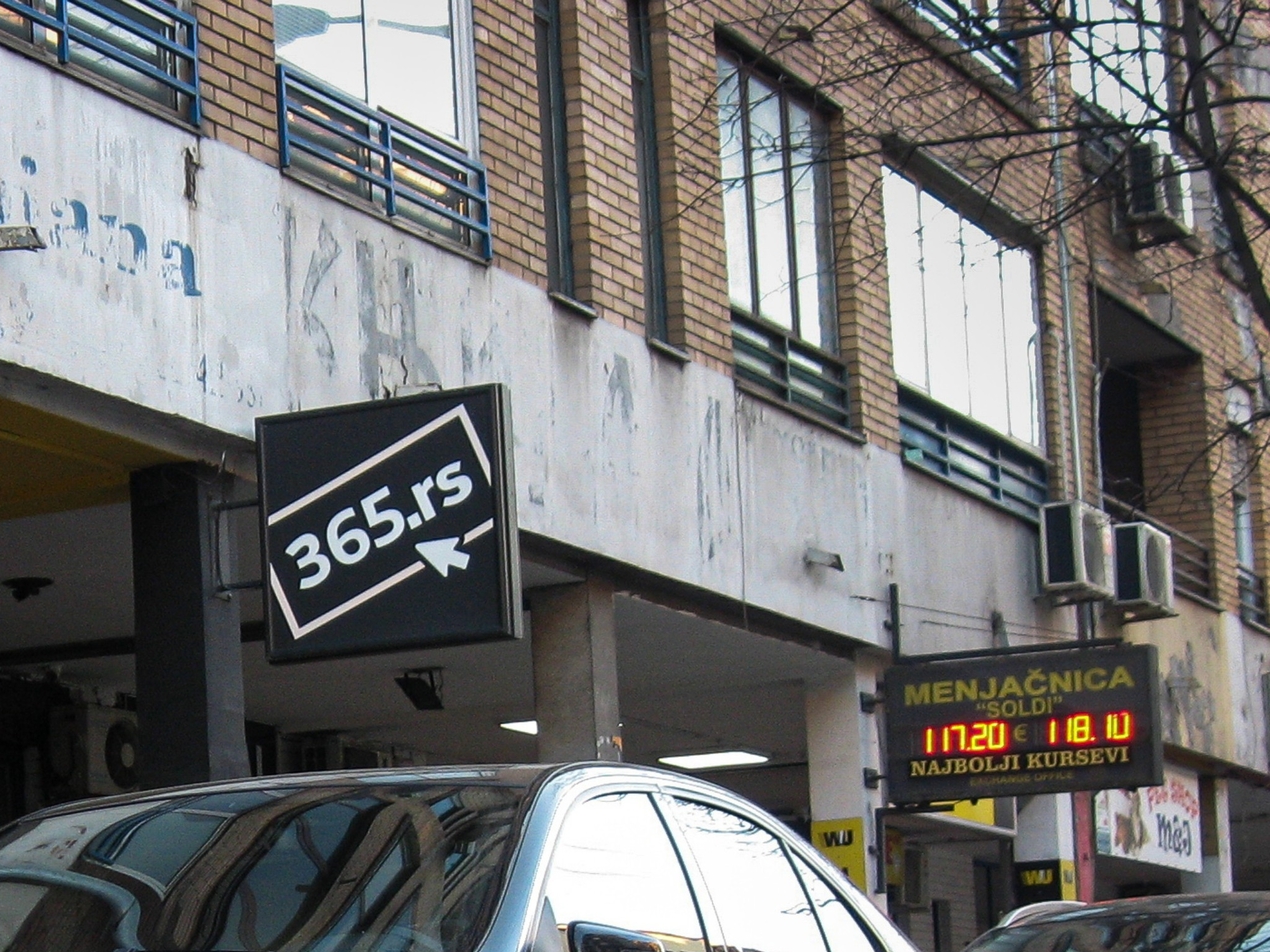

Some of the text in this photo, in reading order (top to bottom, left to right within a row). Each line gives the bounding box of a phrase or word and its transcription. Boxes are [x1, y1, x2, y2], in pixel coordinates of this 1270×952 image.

[285, 458, 473, 590] 365.rs
[904, 665, 1134, 706] MENJAČNICA
[910, 747, 1130, 777] NAJBOLJI KURSEVI
